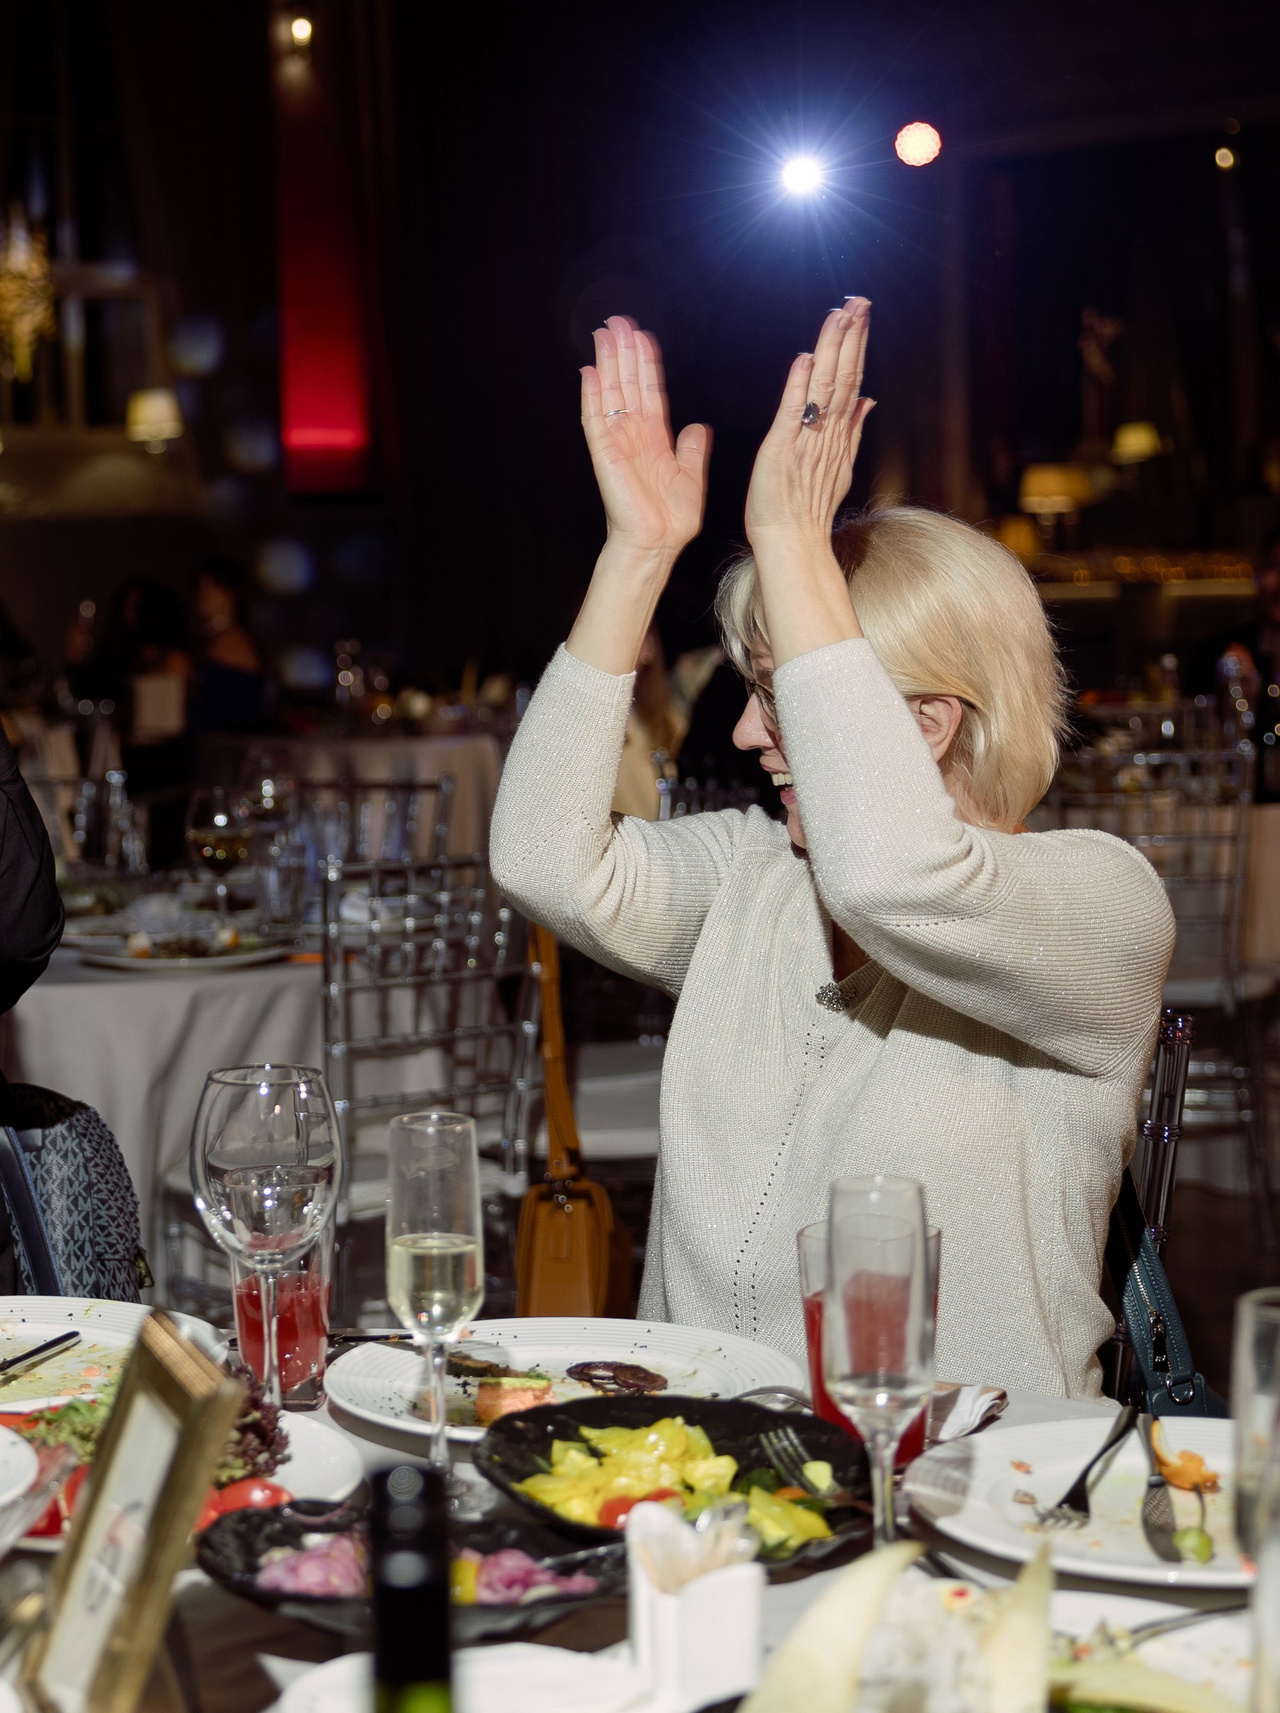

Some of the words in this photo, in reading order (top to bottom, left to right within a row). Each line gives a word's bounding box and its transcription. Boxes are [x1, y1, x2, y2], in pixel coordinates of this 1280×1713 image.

[56, 1136, 80, 1152] MK
[37, 1179, 61, 1196] MK
[63, 1180, 87, 1197] MK
[63, 1210, 87, 1226] MK
[58, 1240, 82, 1256] MK
[71, 1255, 94, 1270] MK
